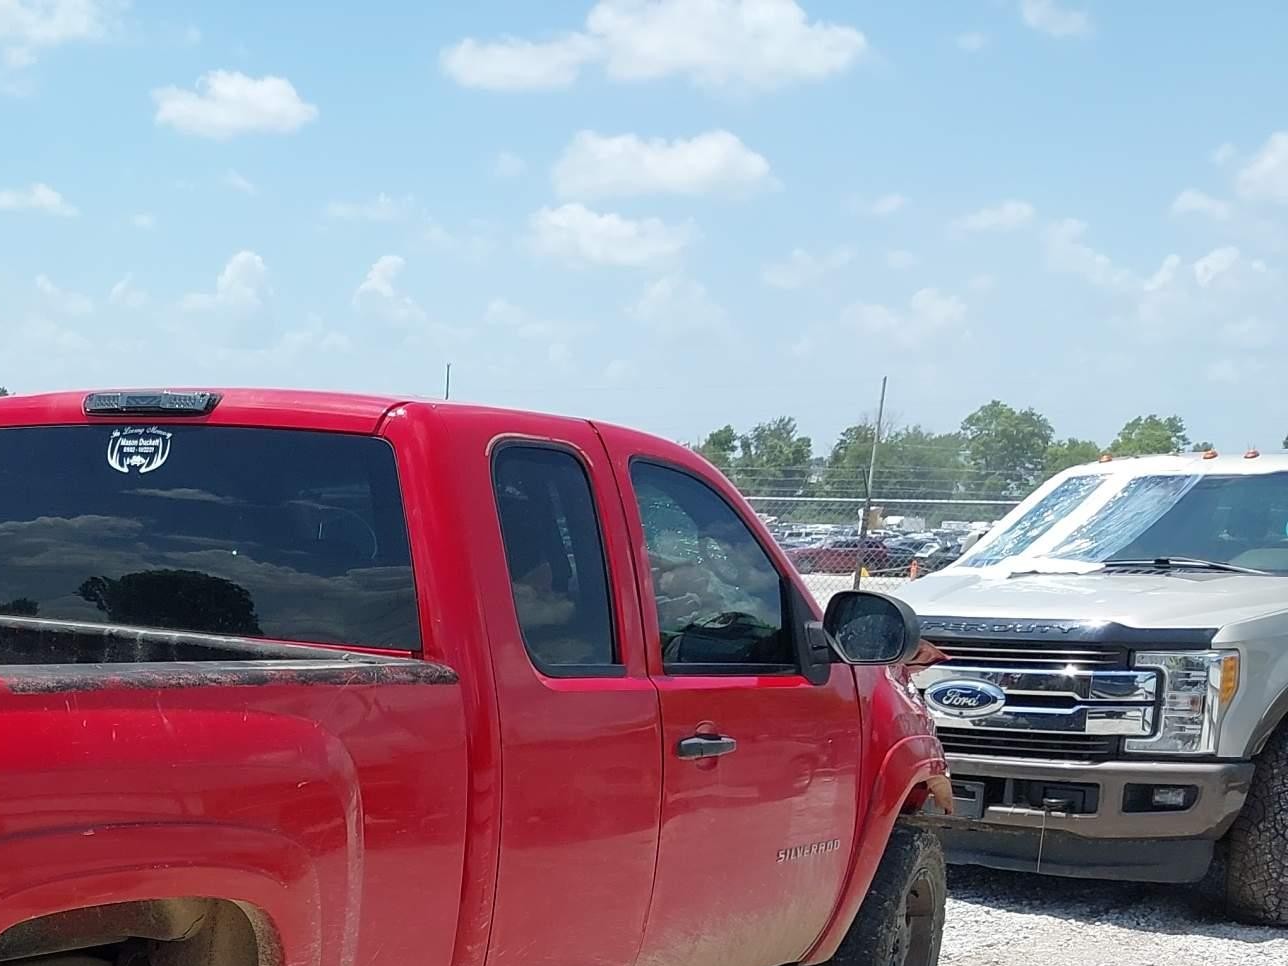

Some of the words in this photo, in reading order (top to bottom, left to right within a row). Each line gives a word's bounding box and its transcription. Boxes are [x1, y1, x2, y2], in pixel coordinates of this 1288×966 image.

[991, 623, 1080, 634] DUTY
[942, 688, 981, 707] Ford
[776, 839, 841, 863] SILVERADO
